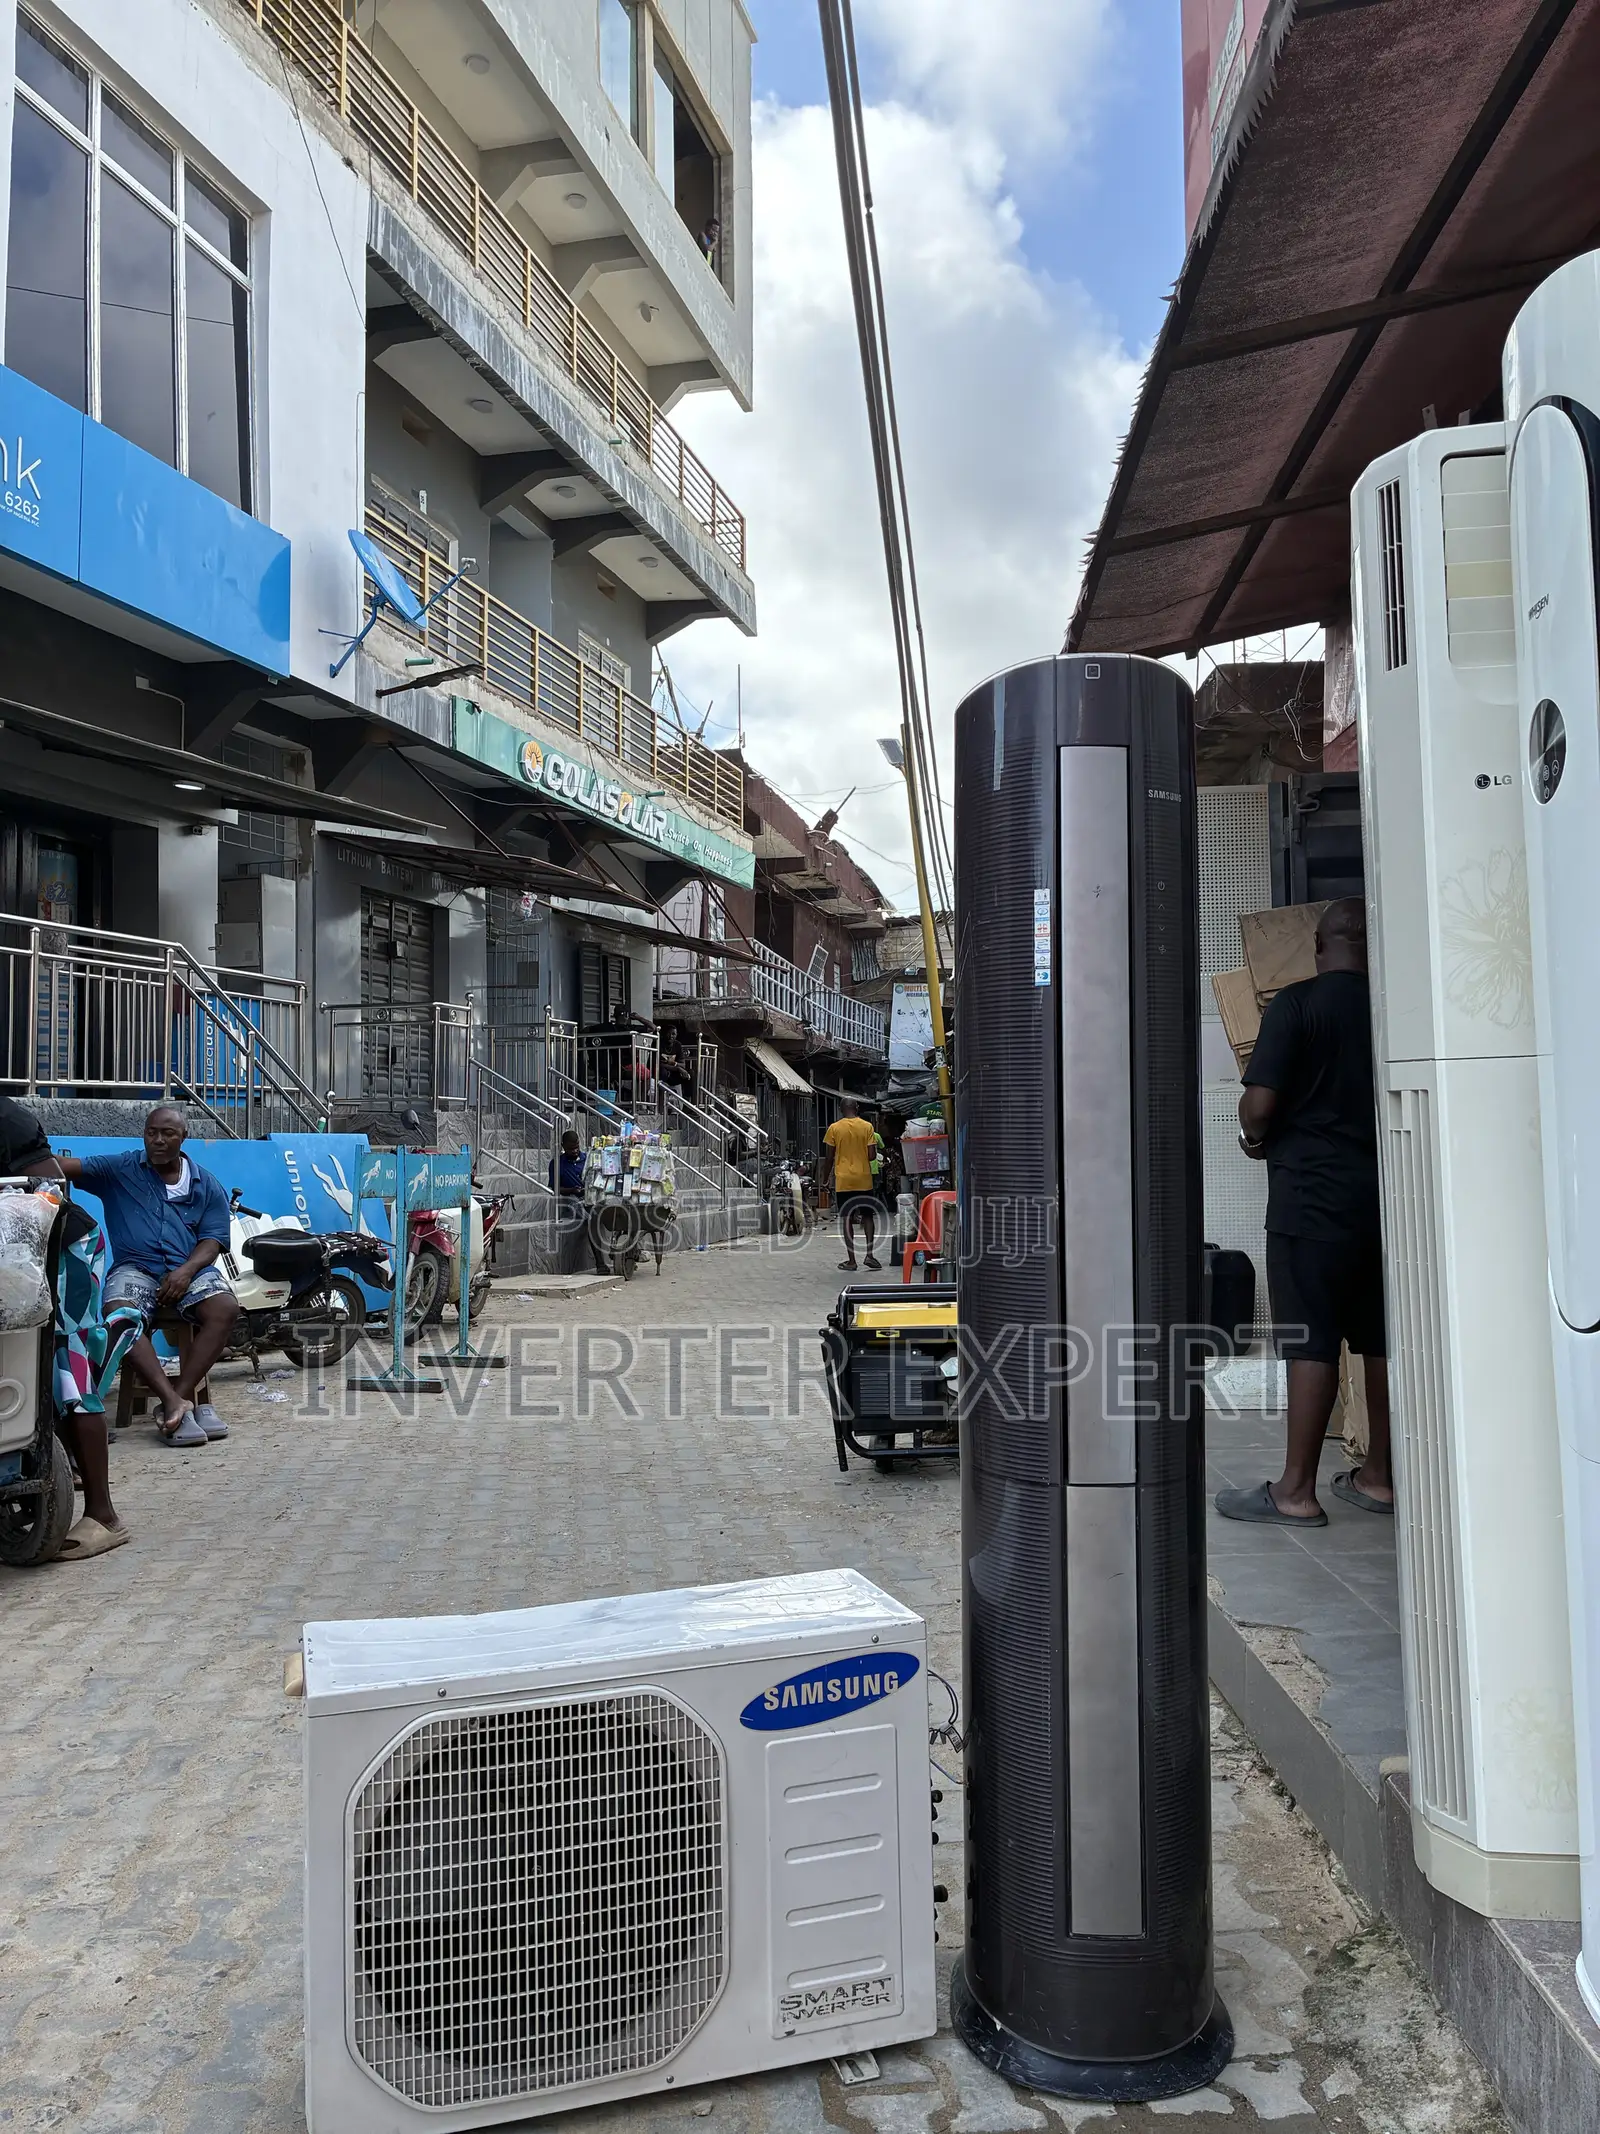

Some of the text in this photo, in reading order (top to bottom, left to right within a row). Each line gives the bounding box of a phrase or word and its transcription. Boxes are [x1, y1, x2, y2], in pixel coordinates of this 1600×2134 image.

[5, 491, 41, 521] 6262
[1528, 593, 1550, 622] WHISEN
[1493, 774, 1513, 786] LG
[1148, 789, 1182, 803] SAMSUNG
[336, 846, 372, 871] LITHIUM
[381, 860, 414, 884] BATTERY
[704, 845, 733, 867] Happiness
[205, 1000, 215, 1085] uionbank
[385, 1169, 395, 1180] NO
[434, 1173, 469, 1188] NO PARKING
[283, 1150, 312, 1230] union
[763, 1671, 899, 1711] SAMSUNG
[780, 1977, 892, 2012] SMART
[782, 1992, 891, 2025] INVERTER
